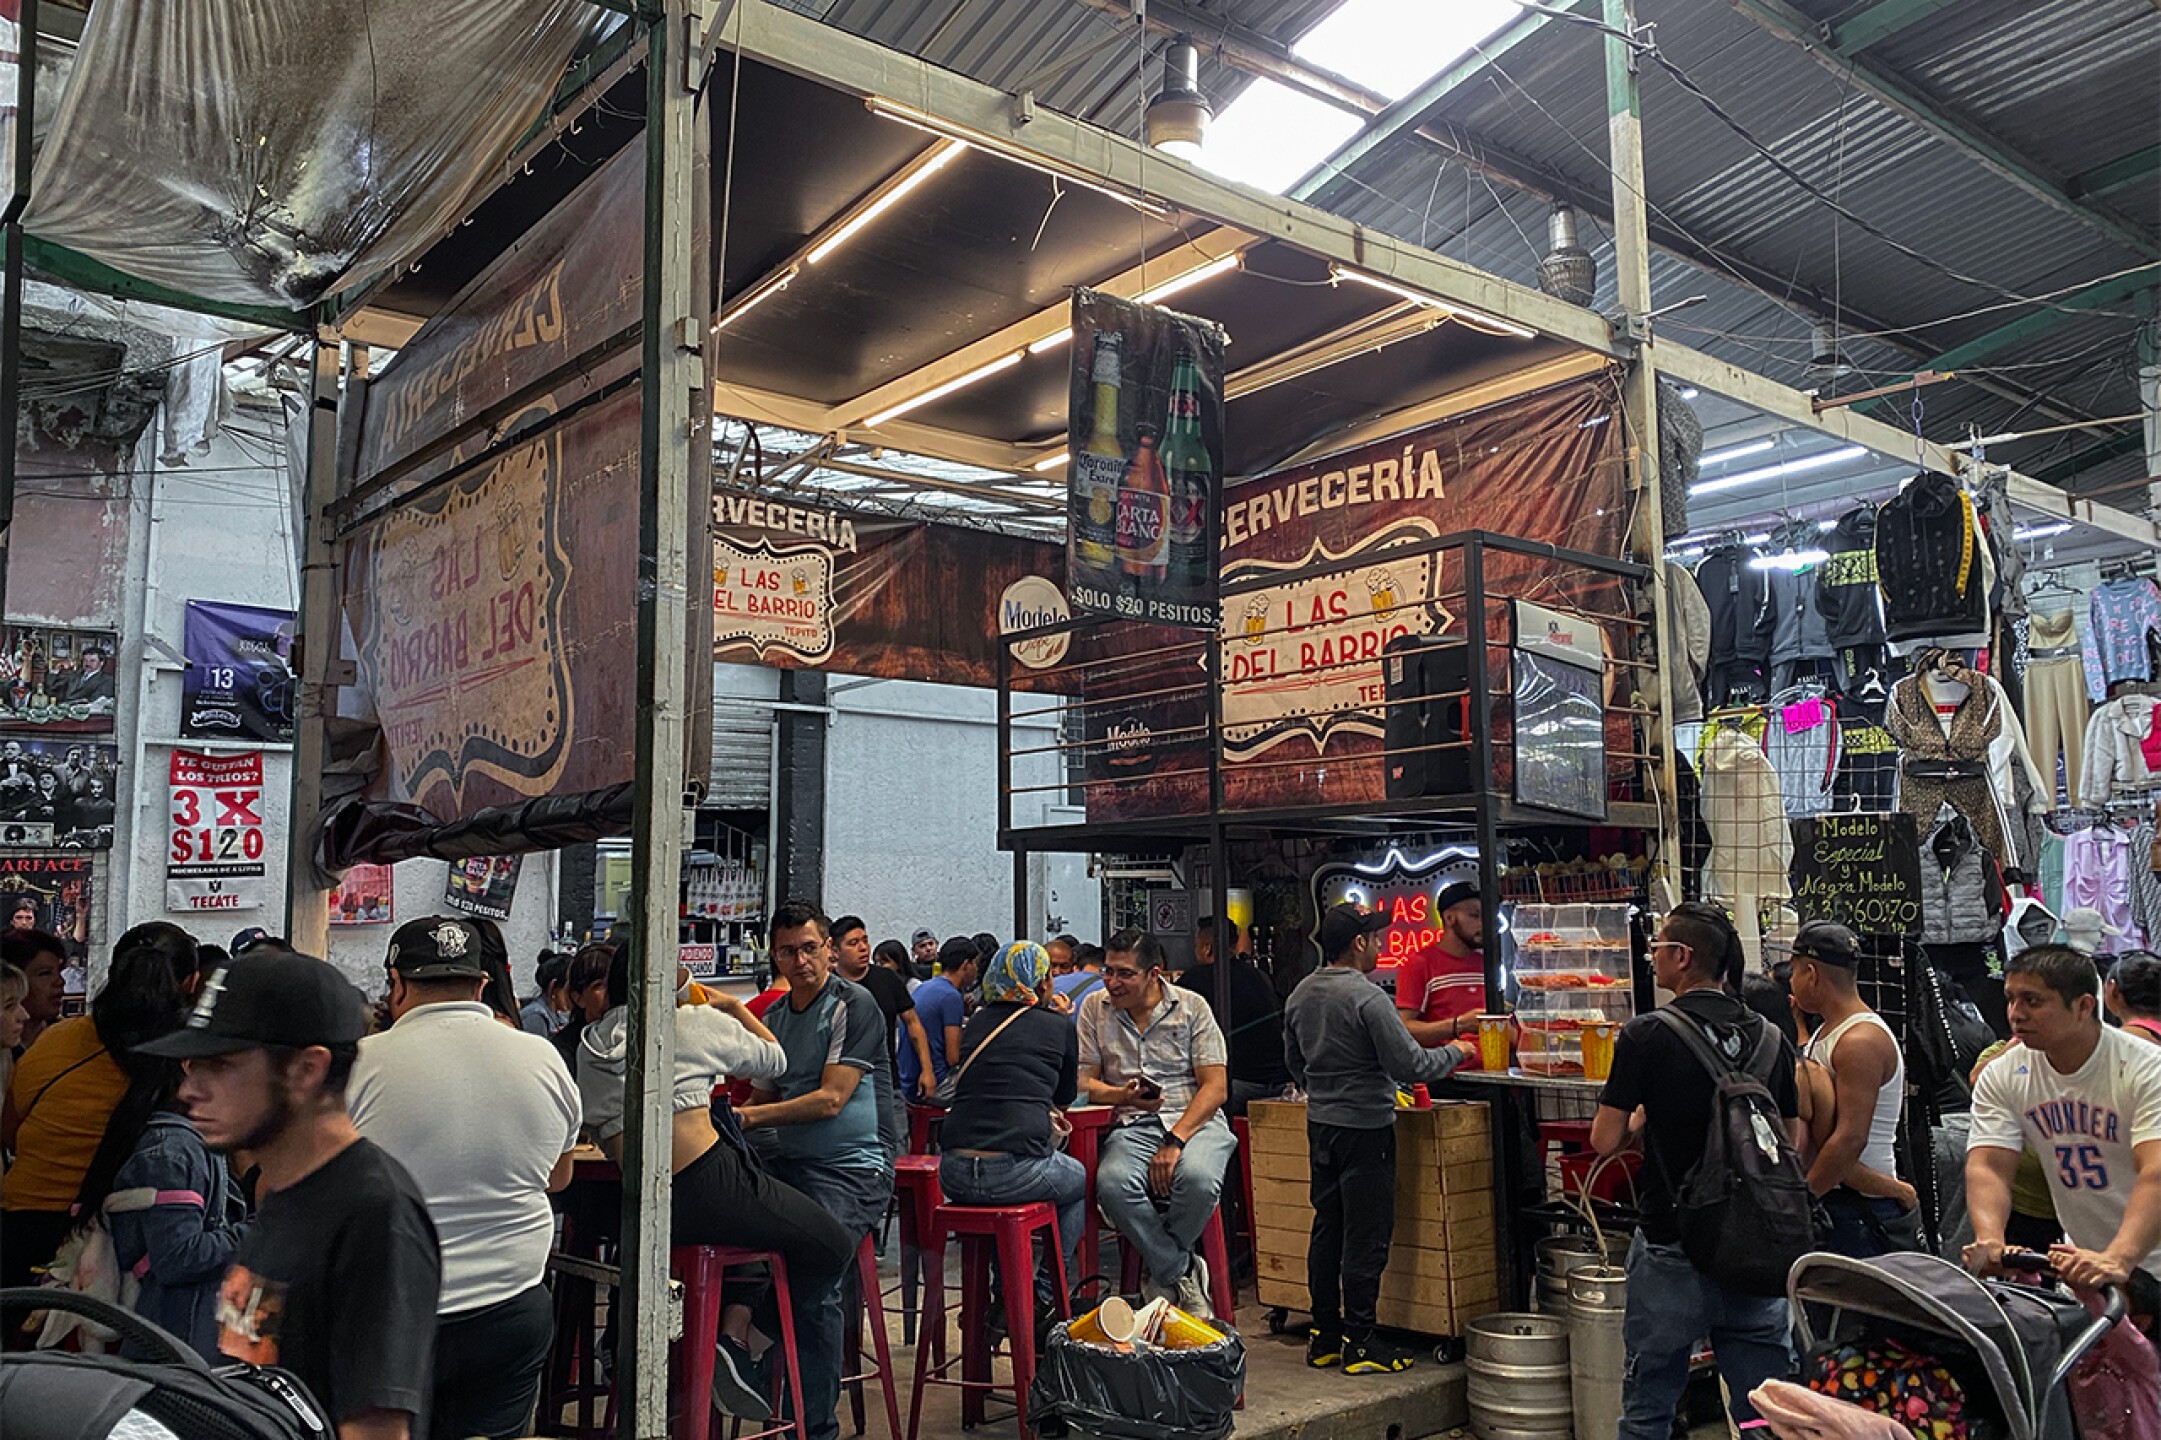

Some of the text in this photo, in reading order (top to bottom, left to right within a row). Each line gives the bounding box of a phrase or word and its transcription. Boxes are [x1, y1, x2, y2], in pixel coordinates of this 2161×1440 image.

[740, 567, 781, 591] LAS
[747, 593, 816, 619] BARRIO
[1004, 599, 1069, 629] Modelo
[1076, 586, 1112, 609] SOLO
[1115, 595, 1144, 616] $20
[1286, 590, 1348, 634] LAS
[784, 626, 818, 638] TEPITO
[210, 667, 234, 689] 13
[1232, 648, 1288, 685] DEL
[176, 771, 259, 783] LOS TRIOS?
[177, 757, 255, 771] TE GUSTAN
[172, 790, 262, 826] 3 X
[1821, 816, 1878, 838] Modelo
[170, 827, 264, 864] $120
[0, 858, 86, 872] ARFACE
[1840, 863, 1852, 879] y
[1797, 870, 1907, 899] Negra Modelo
[191, 895, 239, 908] TECATE
[1388, 929, 1444, 956] BAR
[2053, 1142, 2110, 1192] 35
